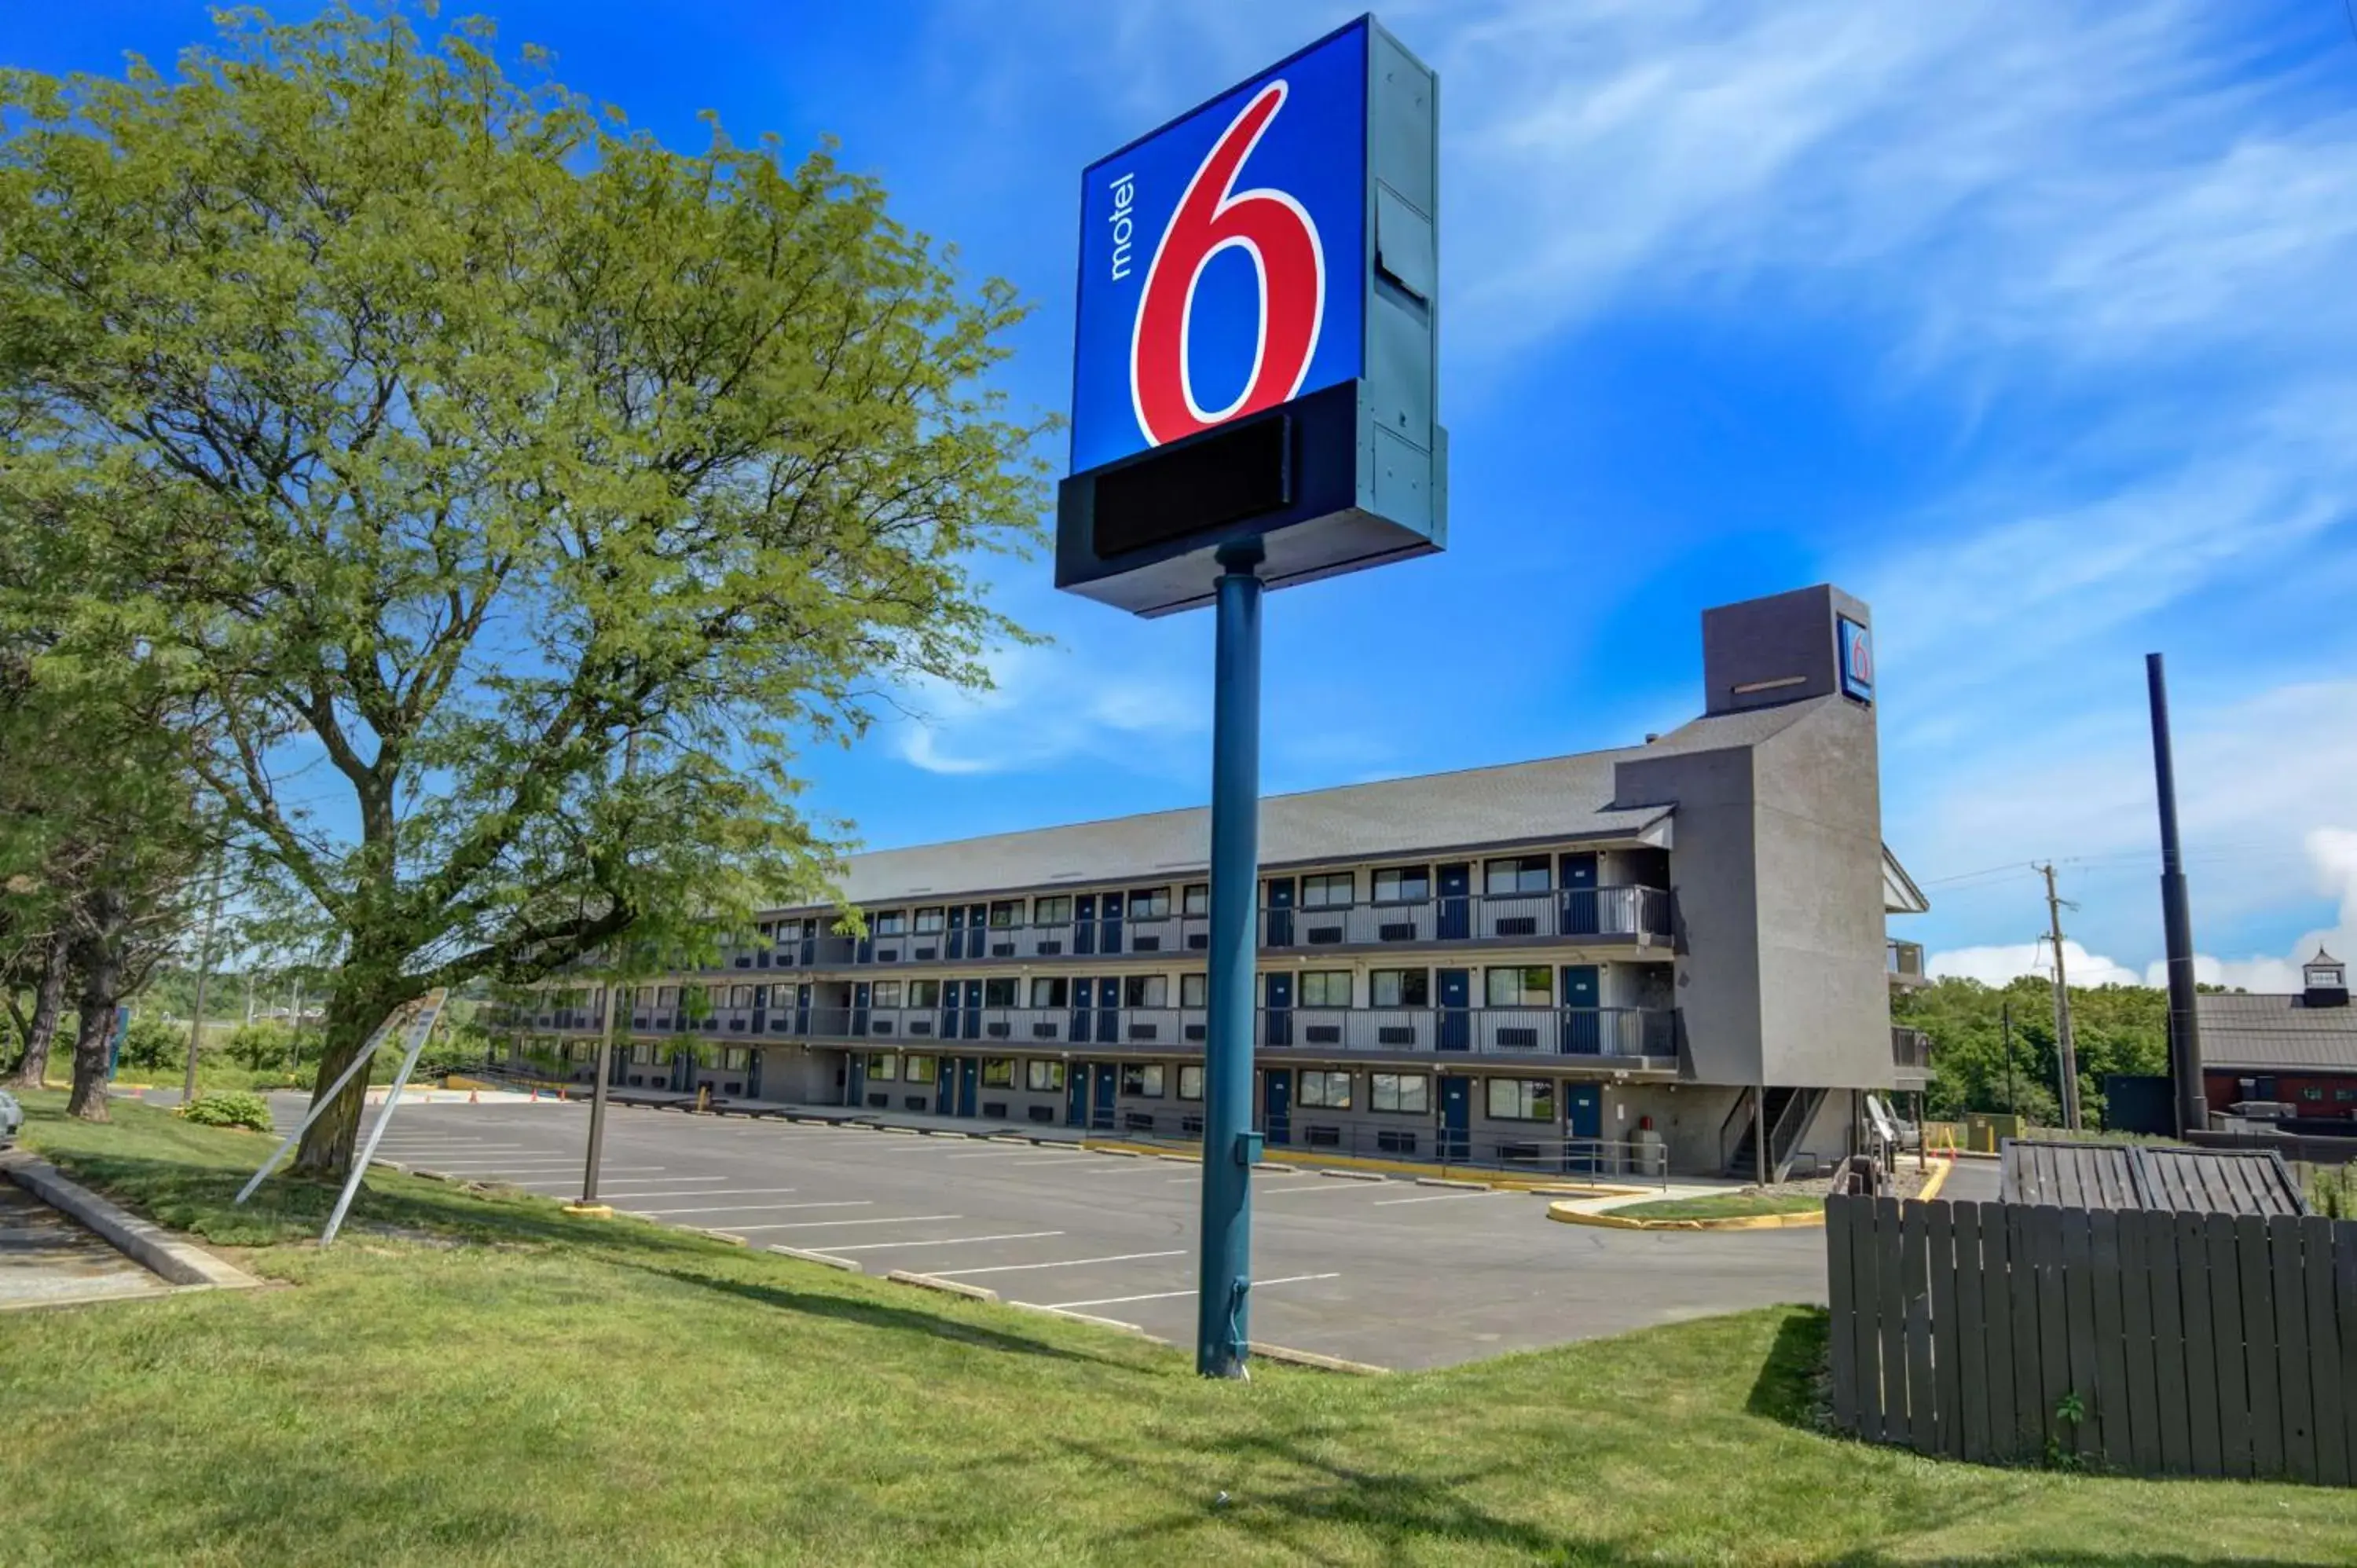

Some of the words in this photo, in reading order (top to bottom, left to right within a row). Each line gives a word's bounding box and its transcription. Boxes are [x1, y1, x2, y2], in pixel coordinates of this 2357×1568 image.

[1109, 171, 1135, 282] motel
[1130, 79, 1325, 448] 6
[1853, 629, 1870, 682] 6
